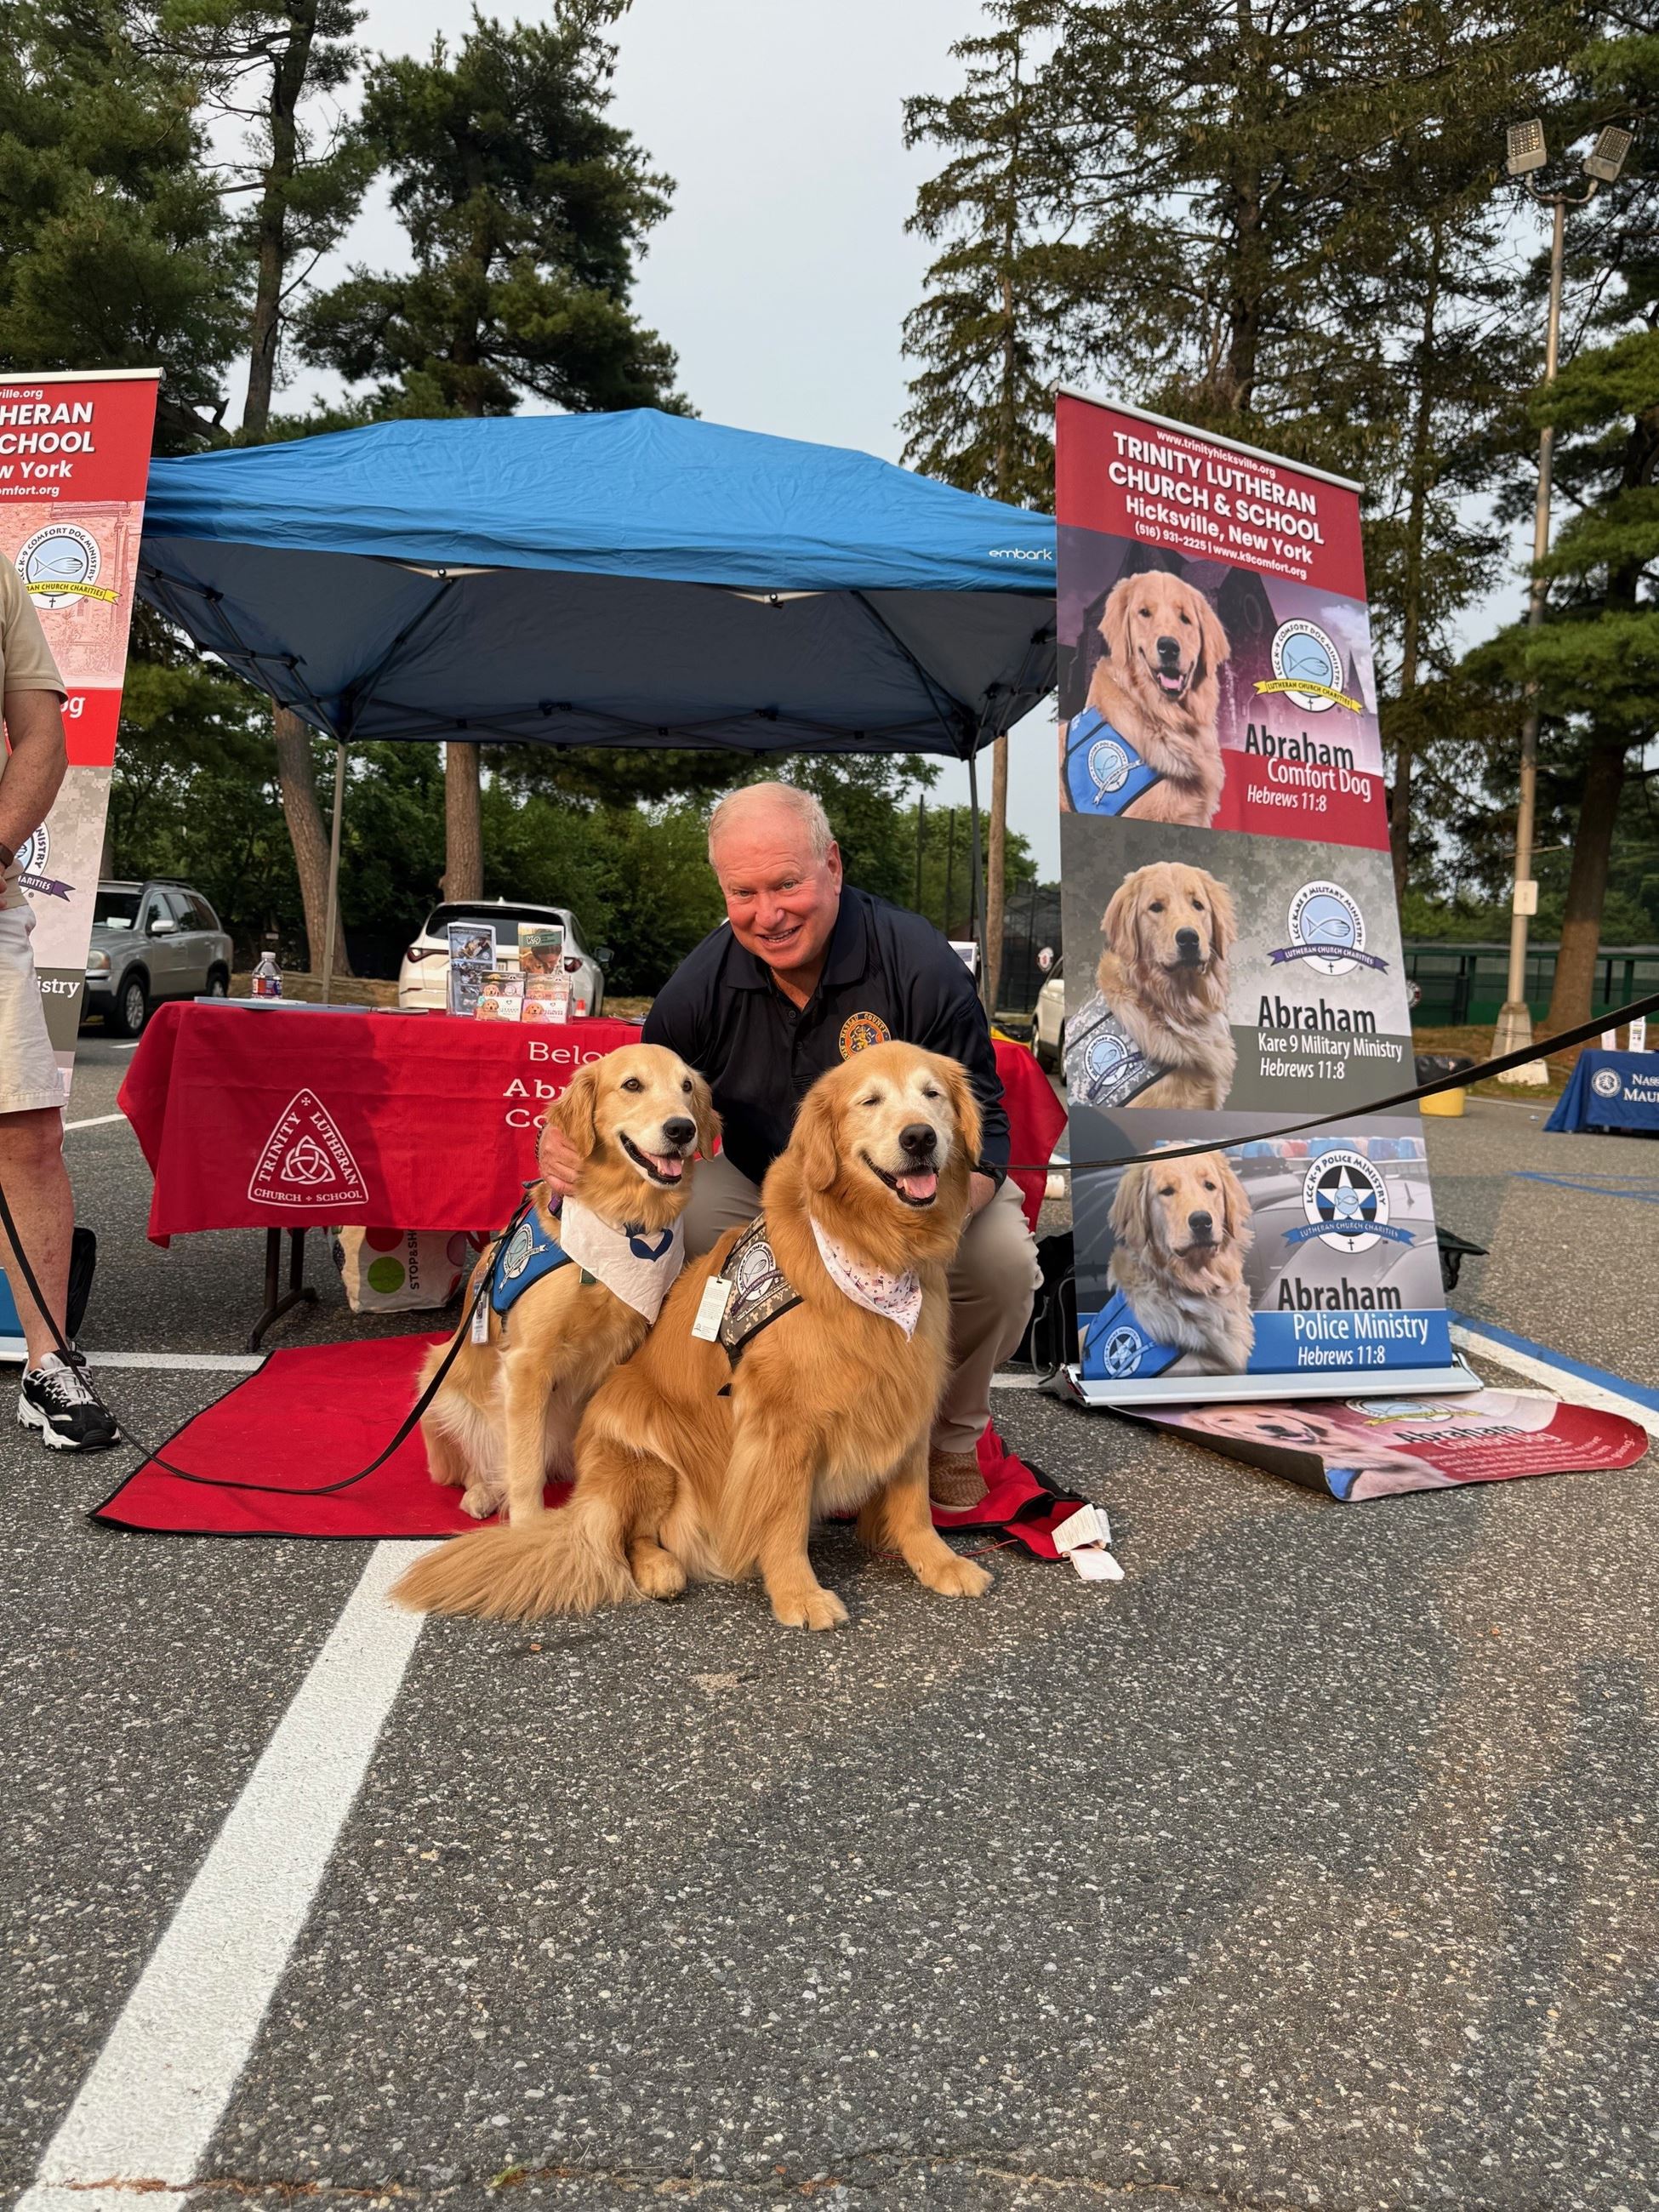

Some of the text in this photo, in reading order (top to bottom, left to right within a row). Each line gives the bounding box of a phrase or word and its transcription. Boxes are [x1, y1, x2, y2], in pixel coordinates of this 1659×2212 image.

[20, 459, 73, 479] York
[1156, 430, 1276, 479] www.trinityhicksville.org
[1113, 431, 1317, 516] TRINITY LUTHERAN
[1109, 462, 1325, 544] CHURCH & SCHOOL
[1126, 494, 1314, 565] Hicksville, New York
[18, 550, 28, 566] K-9
[27, 527, 68, 550] COMFORT
[68, 528, 86, 541] DOG
[84, 540, 97, 581] MINISTRY
[989, 548, 1052, 561] embark
[1135, 522, 1160, 541] (516)
[1163, 530, 1206, 551] 931-2225
[1214, 545, 1307, 580] www.k9comfort.org
[70, 584, 104, 596] CHARITIES
[1278, 624, 1308, 641] COMFORT
[1310, 628, 1325, 643] DOG
[1325, 643, 1341, 687] MINISTRY
[1267, 681, 1351, 706] LUTHERAN CHURCH CHARITIES
[1245, 723, 1355, 770] Abraham
[1268, 757, 1371, 803] Comfort Dog
[1247, 784, 1327, 812] Hebrews 11:8
[35, 828, 47, 869] NISTRY
[18, 875, 51, 890] ARITIES
[1309, 887, 1344, 900] MILITARY
[1344, 899, 1363, 945] MINISTRY
[1285, 945, 1375, 965] LUTHERAN CHURCH CHARITIES
[37, 976, 80, 998] istry
[1258, 995, 1377, 1034] Abraham
[528, 1041, 610, 1064] Belo
[1258, 1032, 1403, 1063] Kare 9 Military Ministry
[1260, 1058, 1345, 1080] Hebrews 11:8
[259, 1111, 359, 1185] TRINITY LUTHERAN
[254, 1188, 362, 1202] CHURCH SCHOOL
[1309, 1166, 1322, 1183] K-9
[1321, 1154, 1352, 1167] POLICE
[1354, 1158, 1387, 1206] MINISTRY
[1300, 1223, 1335, 1238] LUTHERAN
[1364, 1223, 1399, 1238] CHARITIES
[1278, 1277, 1401, 1311] Abraham
[1293, 1313, 1428, 1345] Police Ministry
[1298, 1345, 1386, 1366] Hebrews 11:8
[1394, 1425, 1525, 1443] Abraham
